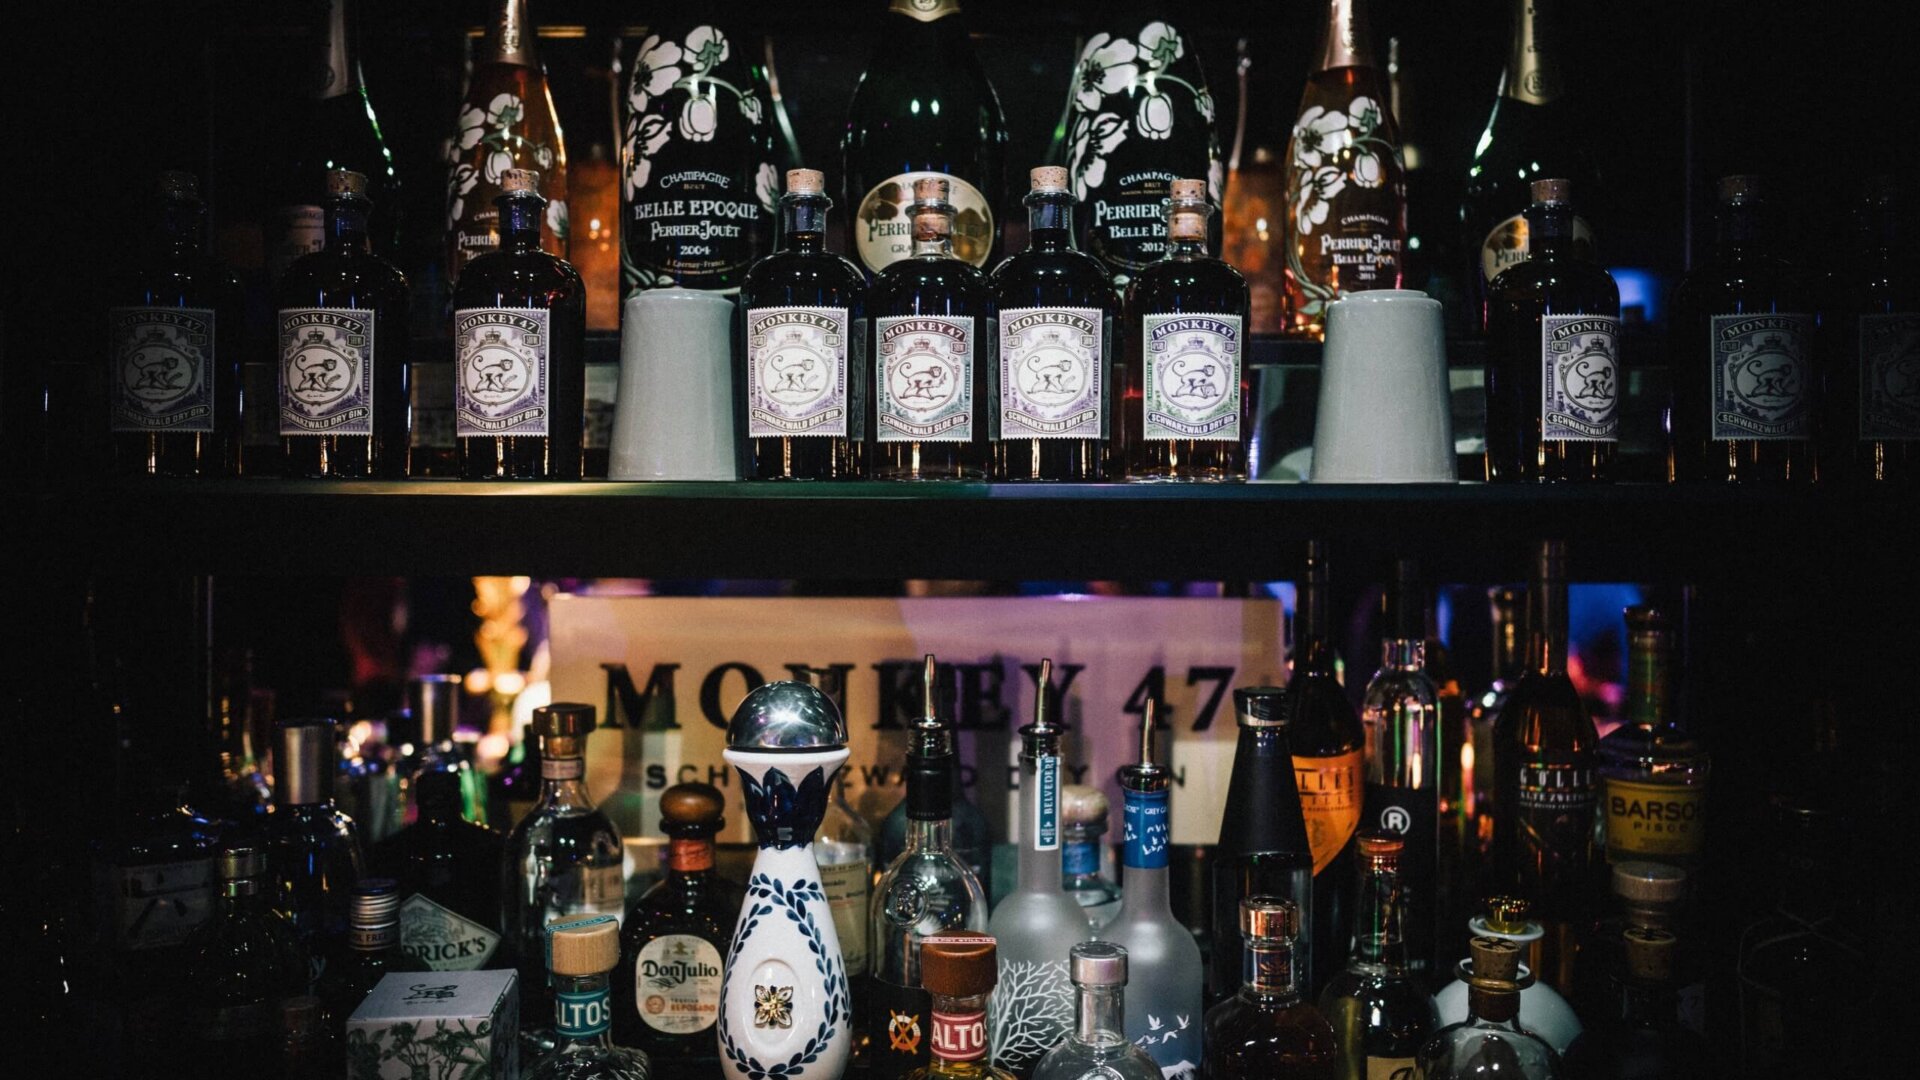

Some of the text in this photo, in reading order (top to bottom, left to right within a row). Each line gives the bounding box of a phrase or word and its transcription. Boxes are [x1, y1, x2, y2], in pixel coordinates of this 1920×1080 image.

[660, 170, 730, 189] CHAMPAGNE
[1119, 171, 1183, 186] CHAMPAGN
[634, 200, 759, 220] BELLE EPOQUE
[1109, 225, 1150, 239] BELLE
[680, 245, 712, 256] 2004
[1332, 253, 1364, 265] BELLE
[284, 313, 361, 331] MONKEY 47
[460, 313, 537, 332] MONKEY 47
[756, 313, 837, 332] MONKEY 47
[884, 320, 964, 340] MONKEY 47
[1010, 313, 1093, 333] MONKEY 47
[1155, 320, 1235, 338] MONKEY 47
[1558, 320, 1614, 339] MONKEY
[331, 414, 348, 426] DRY
[349, 409, 363, 419] GIN
[507, 414, 524, 426] DRY
[524, 410, 540, 420] GIN
[754, 409, 839, 430] SCHWARZWALD DRY GIN
[882, 414, 965, 435] SCHWARZWALD SLOE GIN
[1007, 411, 1095, 431] SCHWARZWALD DRY GIN
[1150, 413, 1236, 433] SCHWARZWALD DRY GIN
[1551, 414, 1607, 435] SCHWARZWALD
[1123, 665, 1236, 731] 47
[1043, 756, 1054, 815] BELVEDERE
[1144, 807, 1160, 816] GREY
[1611, 796, 1696, 821] BARSO
[402, 936, 486, 961] DRICK'S
[932, 1021, 988, 1051] ALTO
